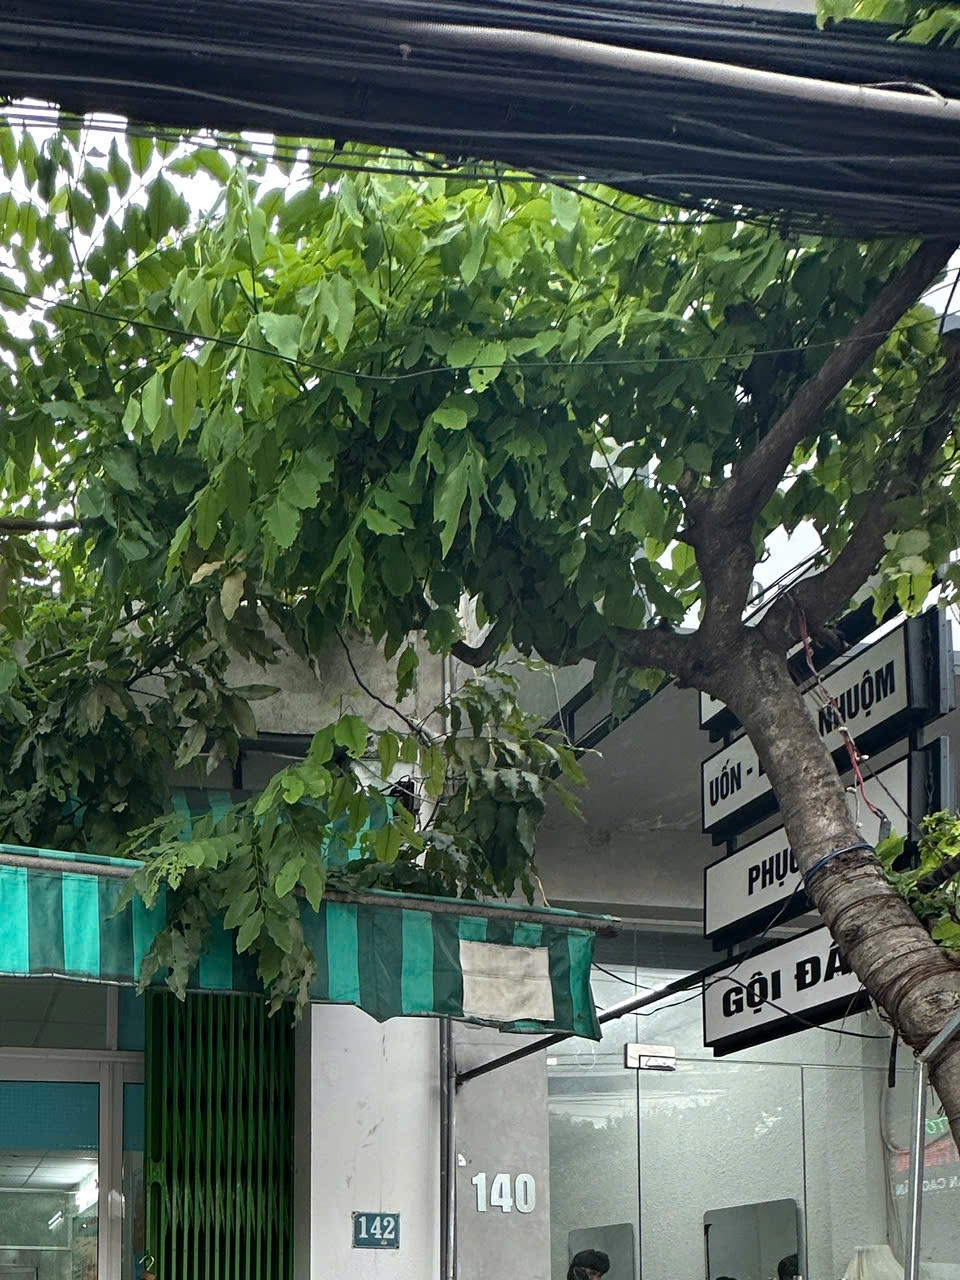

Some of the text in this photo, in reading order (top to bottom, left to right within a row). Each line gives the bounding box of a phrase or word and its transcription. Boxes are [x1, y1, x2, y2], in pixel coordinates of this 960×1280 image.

[709, 758, 742, 807] UỐN
[818, 659, 896, 737] NHUỘM
[722, 969, 781, 1018] GỘI
[471, 1172, 536, 1214] 140
[358, 1216, 396, 1239] 142
